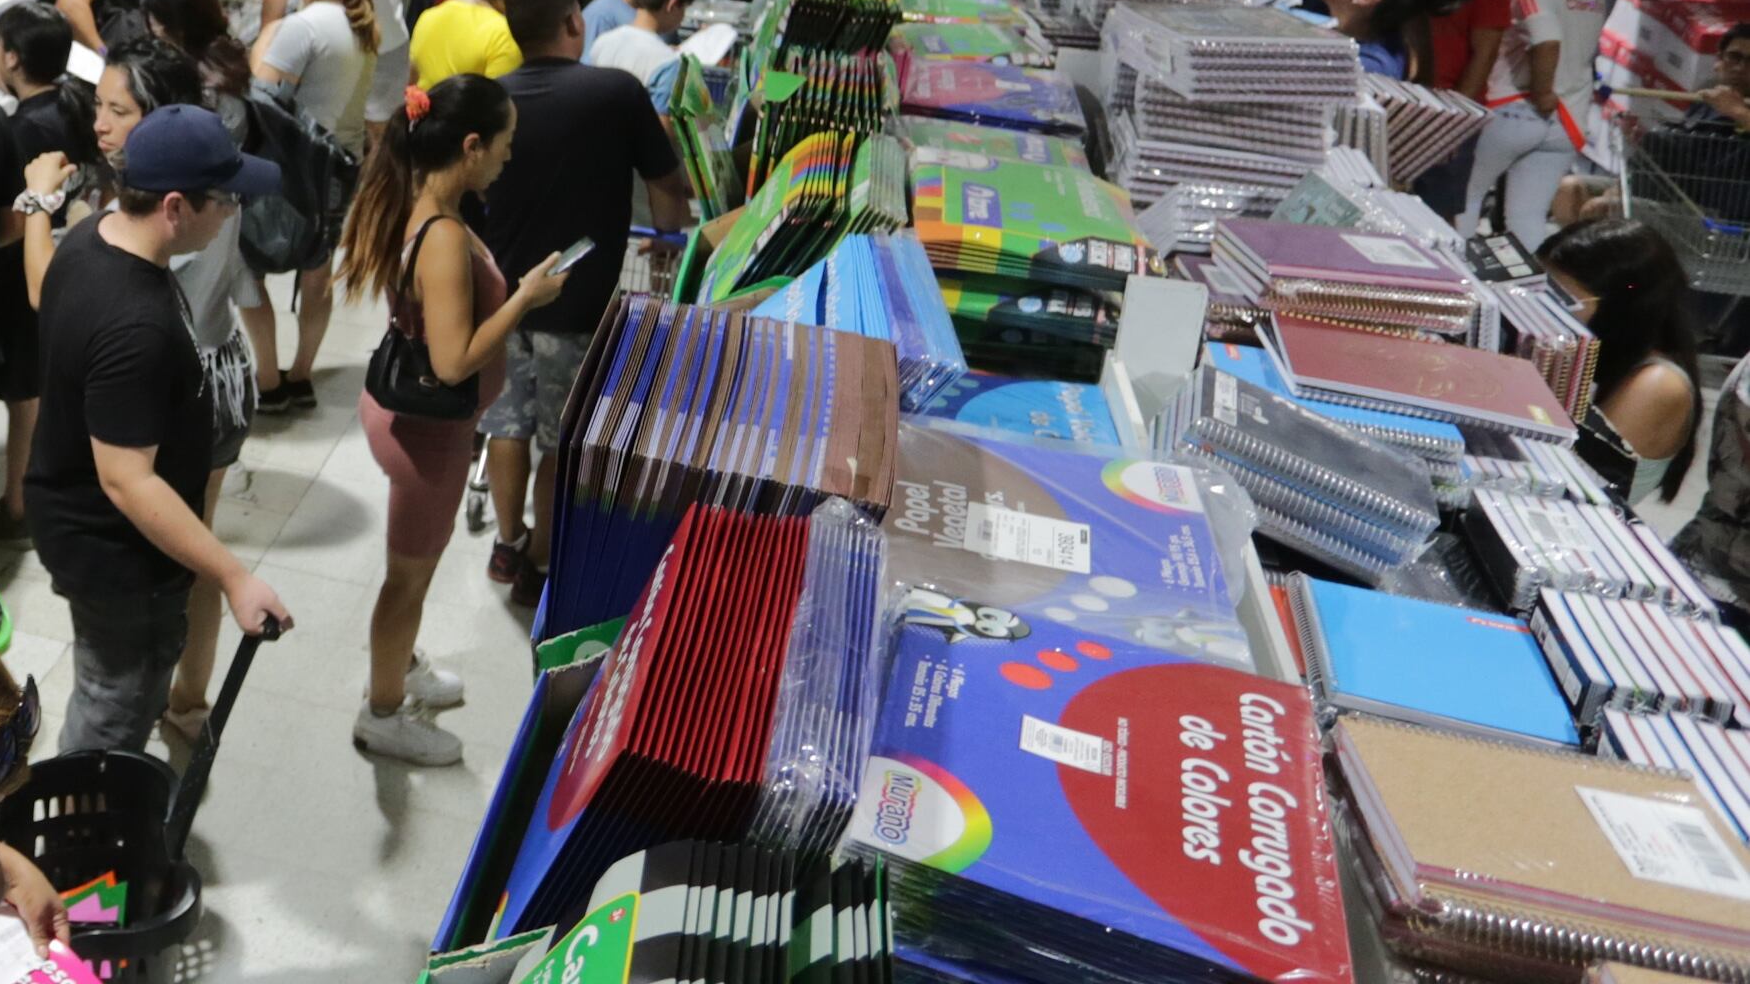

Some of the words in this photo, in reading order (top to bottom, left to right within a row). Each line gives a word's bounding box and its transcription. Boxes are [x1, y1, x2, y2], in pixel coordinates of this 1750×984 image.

[895, 482, 932, 536] Papel
[1179, 715, 1226, 751] de
[1239, 692, 1291, 775] Cartón
[877, 771, 920, 844] Murano
[1183, 759, 1232, 864] Colores
[1239, 782, 1313, 945] Corrugado
